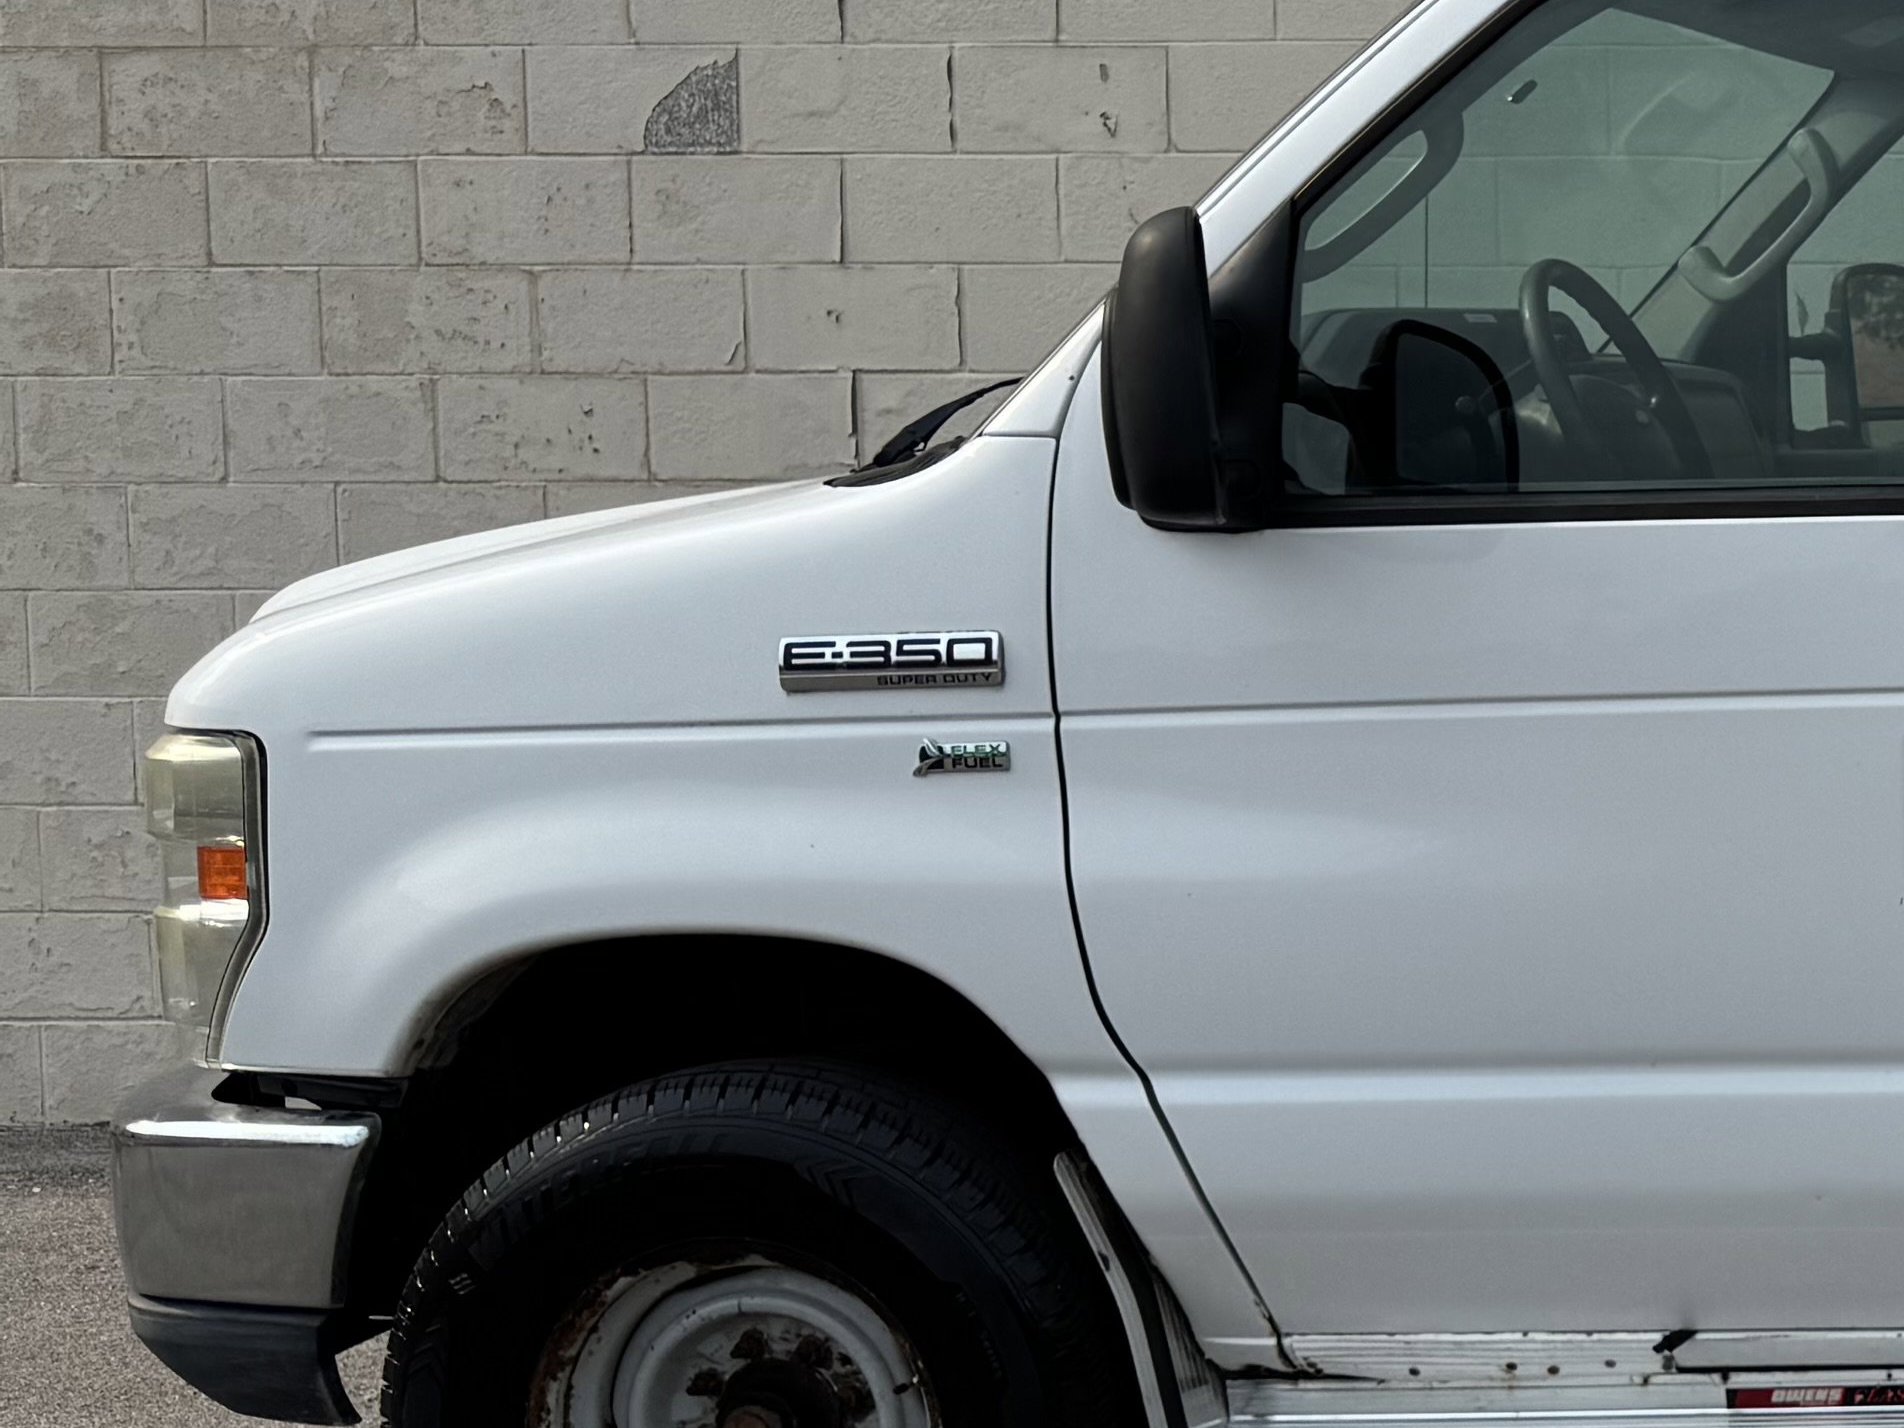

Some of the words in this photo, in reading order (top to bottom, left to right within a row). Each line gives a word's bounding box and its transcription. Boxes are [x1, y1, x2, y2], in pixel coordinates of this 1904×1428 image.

[783, 637, 993, 671] E-350
[877, 673, 937, 687] SUPER
[942, 672, 993, 684] DUTY
[950, 743, 1002, 756] FLEX
[951, 756, 1004, 770] FUEL
[1770, 1387, 1843, 1406] OWENS
